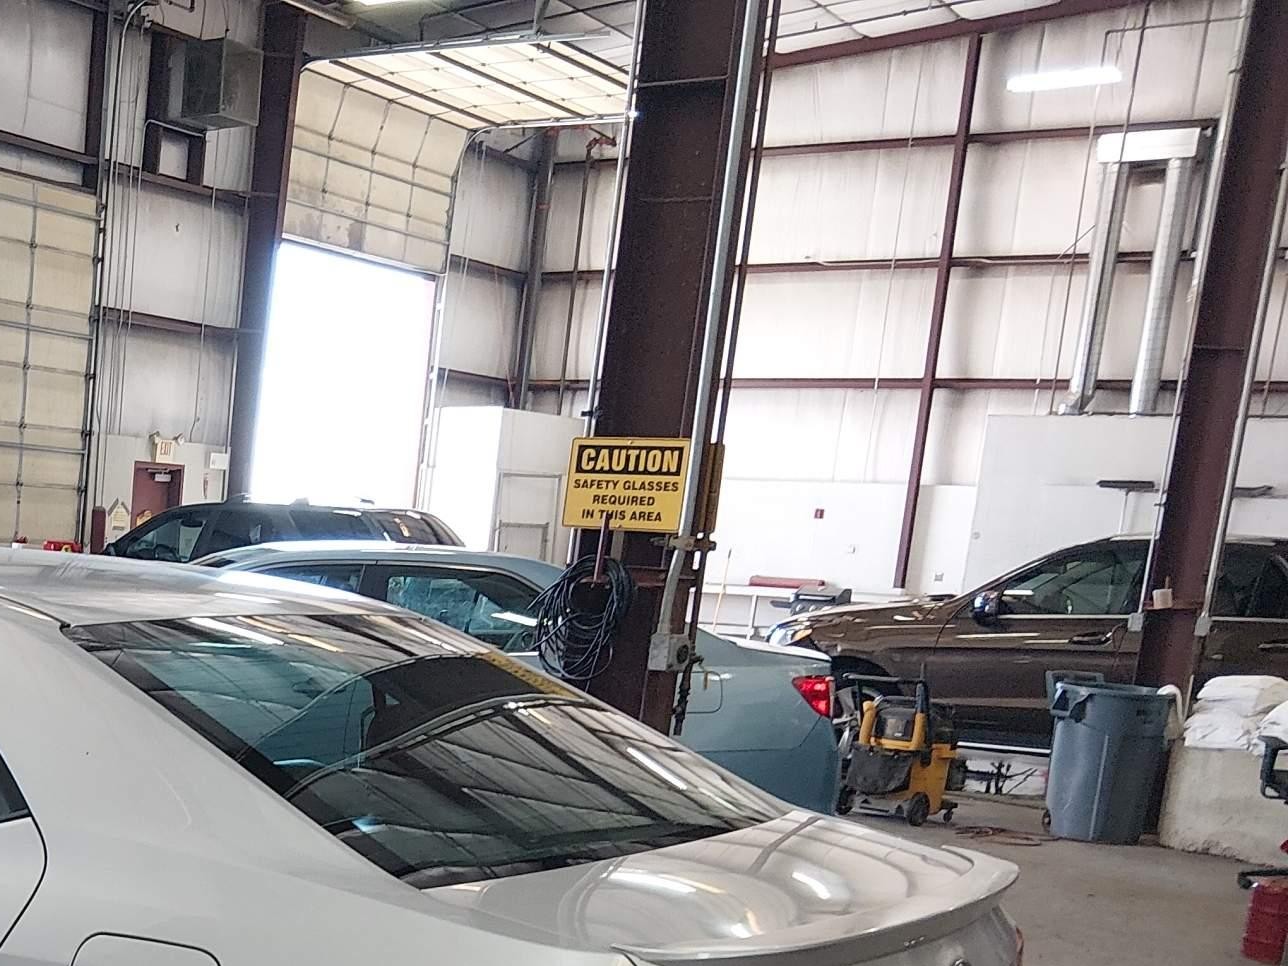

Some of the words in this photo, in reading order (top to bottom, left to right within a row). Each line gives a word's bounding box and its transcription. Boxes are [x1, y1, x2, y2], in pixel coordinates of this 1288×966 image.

[159, 441, 172, 456] EXIT
[580, 448, 680, 473] CAUTION
[573, 478, 620, 490] SAFETY
[622, 480, 679, 492] GLASSES
[592, 494, 655, 506] REQUIRED
[581, 508, 594, 519] IN
[598, 509, 626, 520] THIS
[629, 511, 662, 522] AREA
